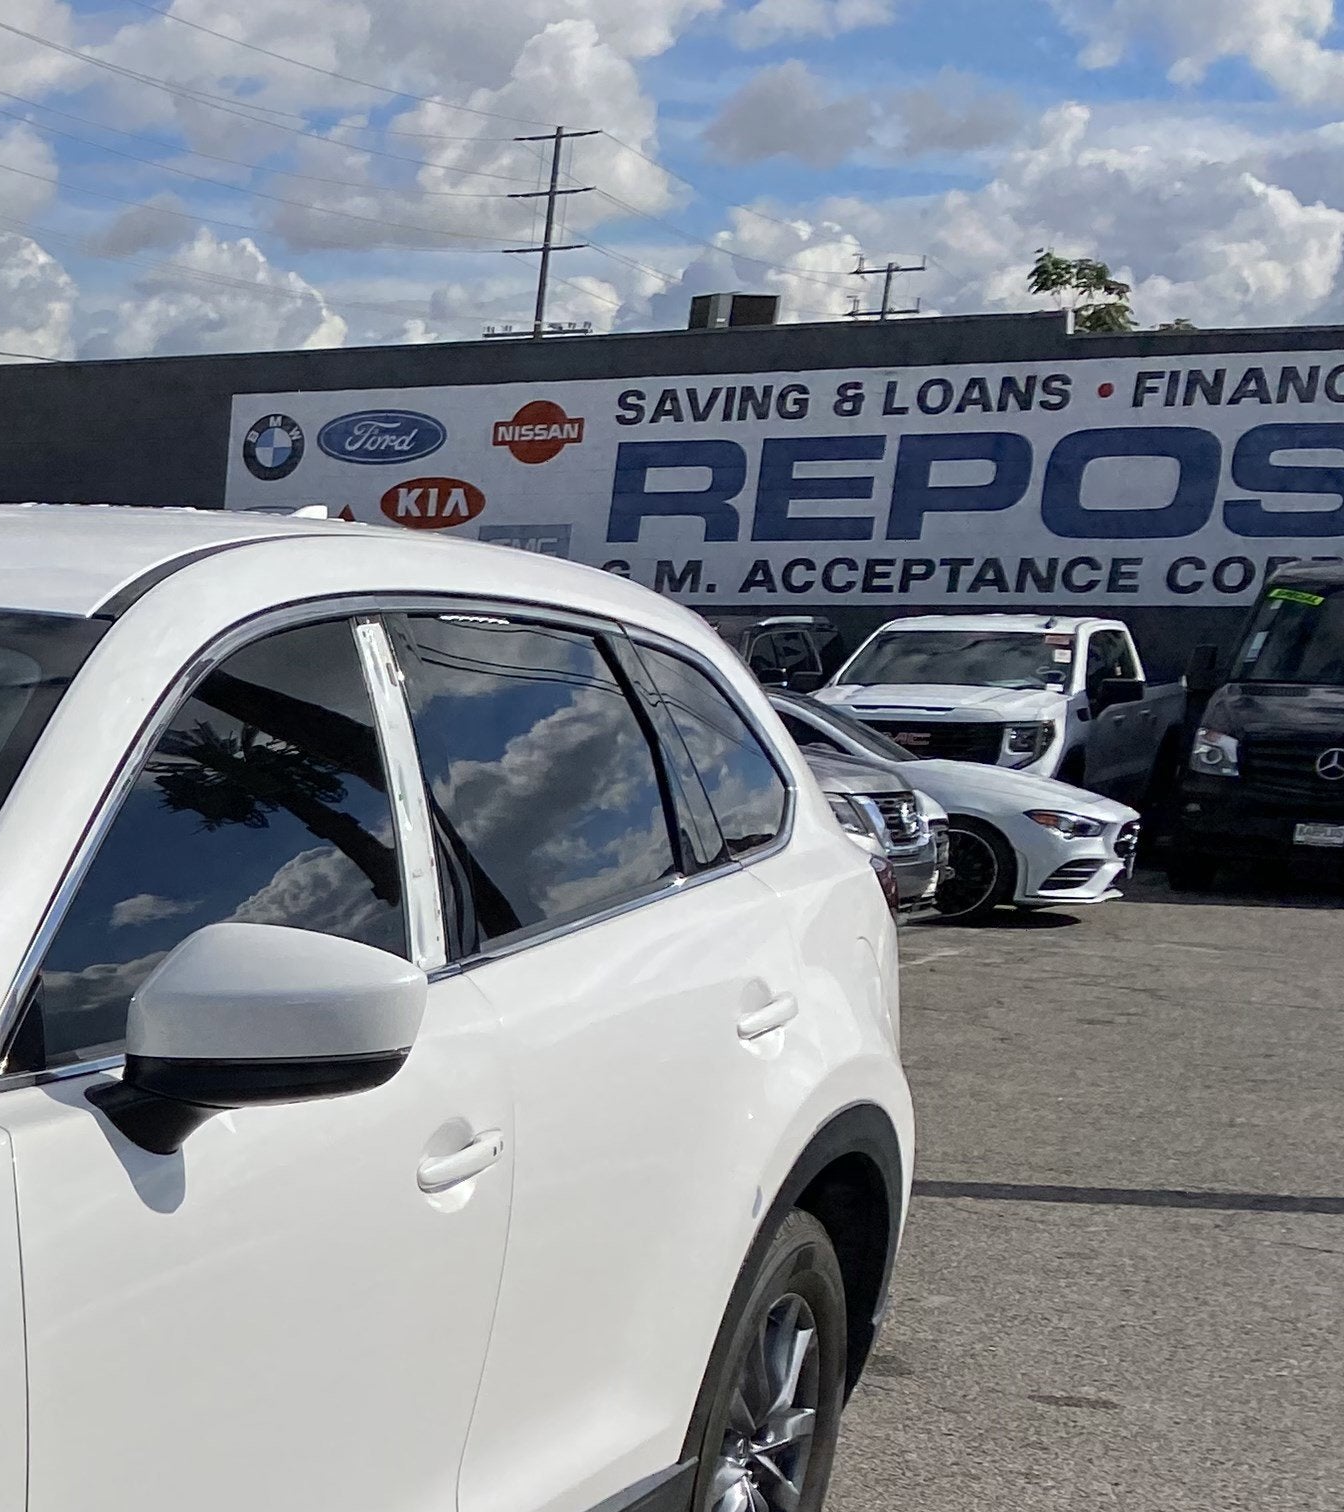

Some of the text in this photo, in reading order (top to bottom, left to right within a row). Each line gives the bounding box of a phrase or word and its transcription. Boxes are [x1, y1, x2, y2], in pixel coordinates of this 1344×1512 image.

[615, 384, 810, 425] SAVING
[832, 381, 866, 417] &
[882, 373, 1072, 416] LOANS
[247, 415, 305, 444] BMW
[344, 420, 418, 451] Ford
[497, 422, 580, 443] NISSAN
[606, 422, 1344, 543] REPOS
[395, 487, 470, 518] KIA
[738, 555, 1144, 594] ACCEPTANCE
